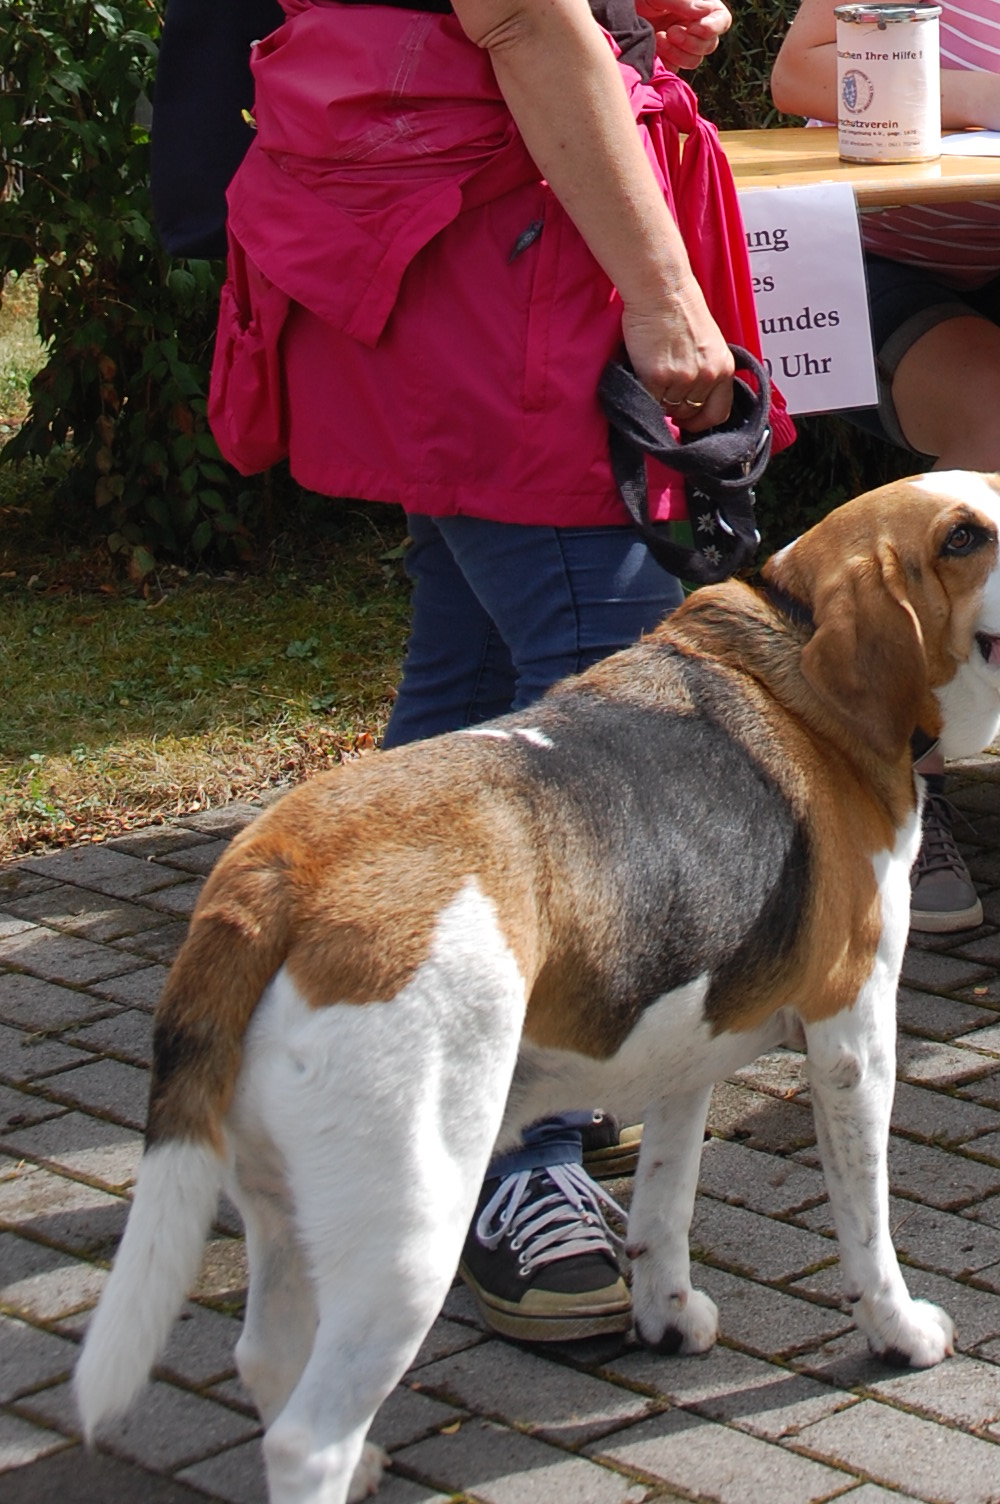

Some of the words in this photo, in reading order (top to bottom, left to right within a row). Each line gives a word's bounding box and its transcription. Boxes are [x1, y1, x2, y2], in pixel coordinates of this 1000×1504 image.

[865, 51, 889, 61] Ihre
[892, 50, 917, 60] Hilfe
[759, 306, 840, 334] undes
[780, 353, 832, 377] Uhr
